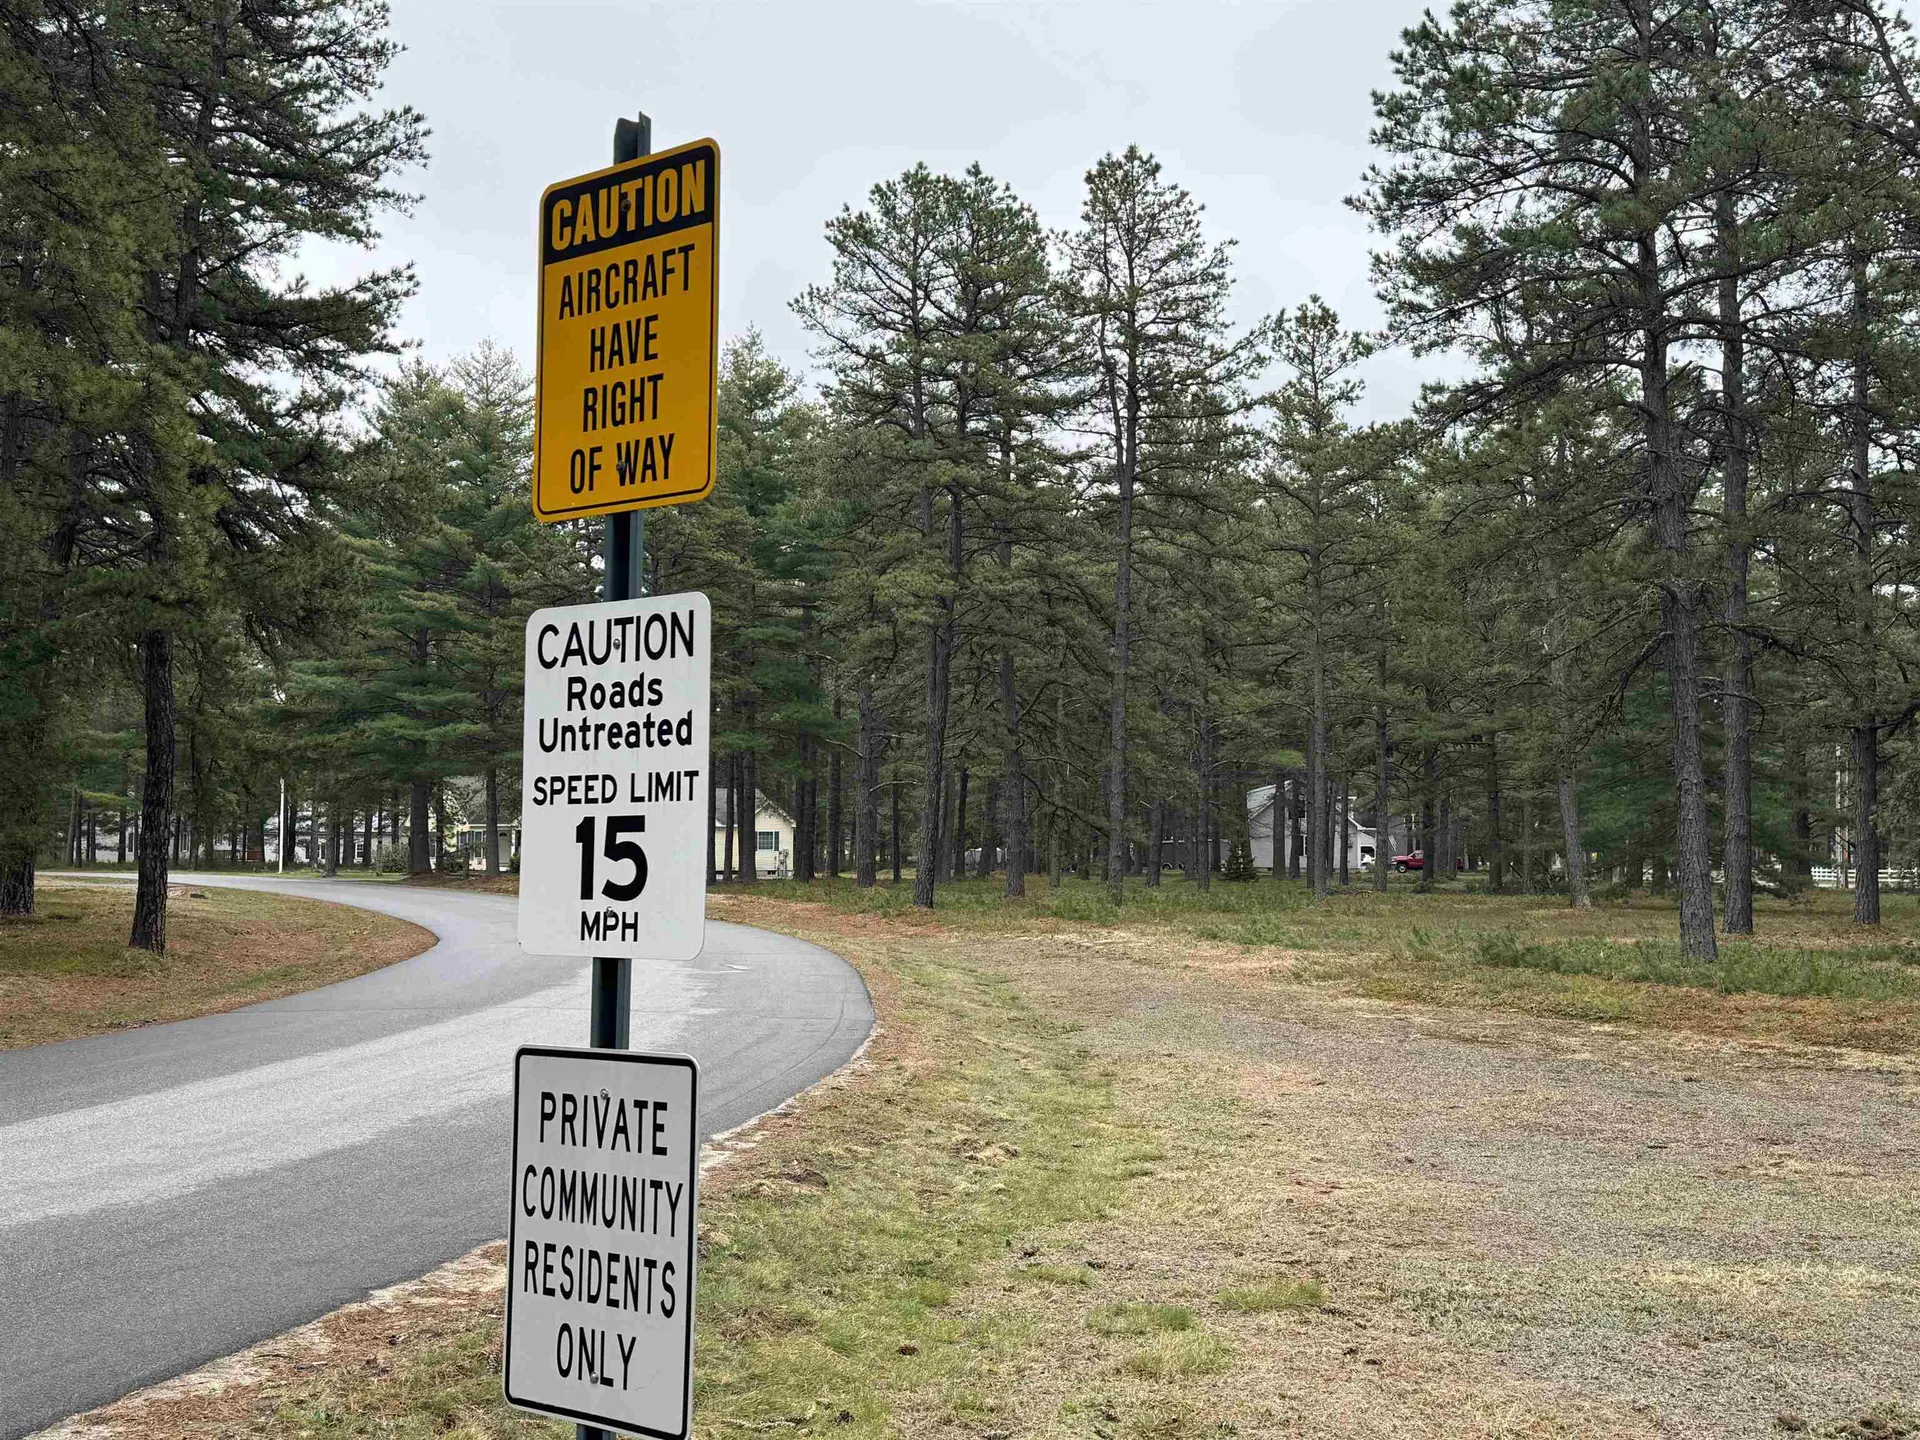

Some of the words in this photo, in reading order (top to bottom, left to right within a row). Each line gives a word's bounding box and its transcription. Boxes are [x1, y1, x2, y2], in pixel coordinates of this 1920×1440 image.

[551, 159, 706, 251] CAUTION
[559, 243, 695, 320] AIRCRAFT
[590, 314, 658, 372] HAVE
[583, 373, 664, 432] RIGHT
[570, 446, 603, 494] OF
[616, 433, 674, 487] WAY
[538, 610, 694, 669] CAUTION
[567, 672, 663, 711] Roads
[539, 710, 692, 752] Untreated
[533, 774, 617, 806] SPEED
[631, 770, 699, 803] LIMIT
[576, 815, 648, 901] 15
[581, 908, 638, 942] MPH
[540, 1092, 667, 1156] PRIVATE
[523, 1165, 683, 1237] COMMUNITY
[524, 1240, 675, 1318] RESIDENTS
[557, 1323, 636, 1390] ONLY
